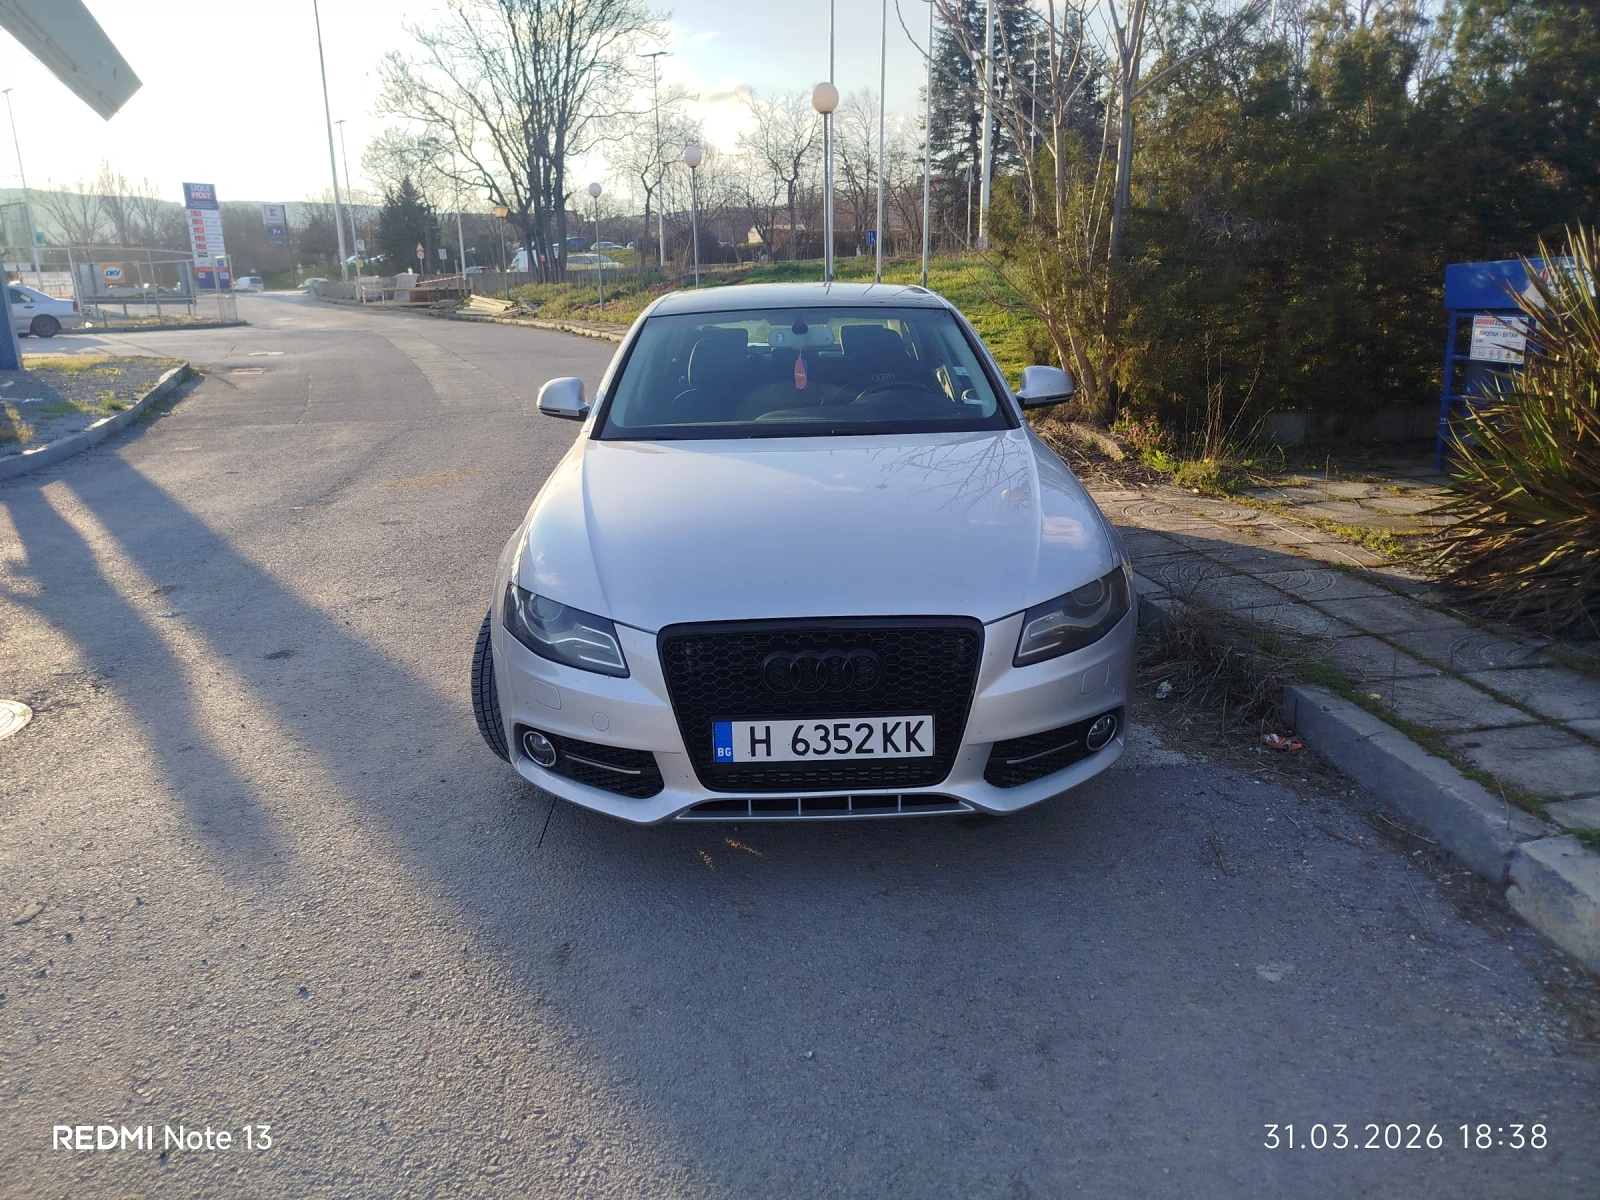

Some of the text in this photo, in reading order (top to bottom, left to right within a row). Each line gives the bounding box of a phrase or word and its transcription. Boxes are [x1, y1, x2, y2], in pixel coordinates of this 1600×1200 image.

[190, 184, 210, 192] LIQUI
[191, 191, 212, 200] MOLY
[105, 269, 121, 277] DKV
[1502, 331, 1519, 339] БУТАН
[790, 722, 875, 756] 6352
[882, 720, 926, 754] KK
[717, 747, 732, 757] BG
